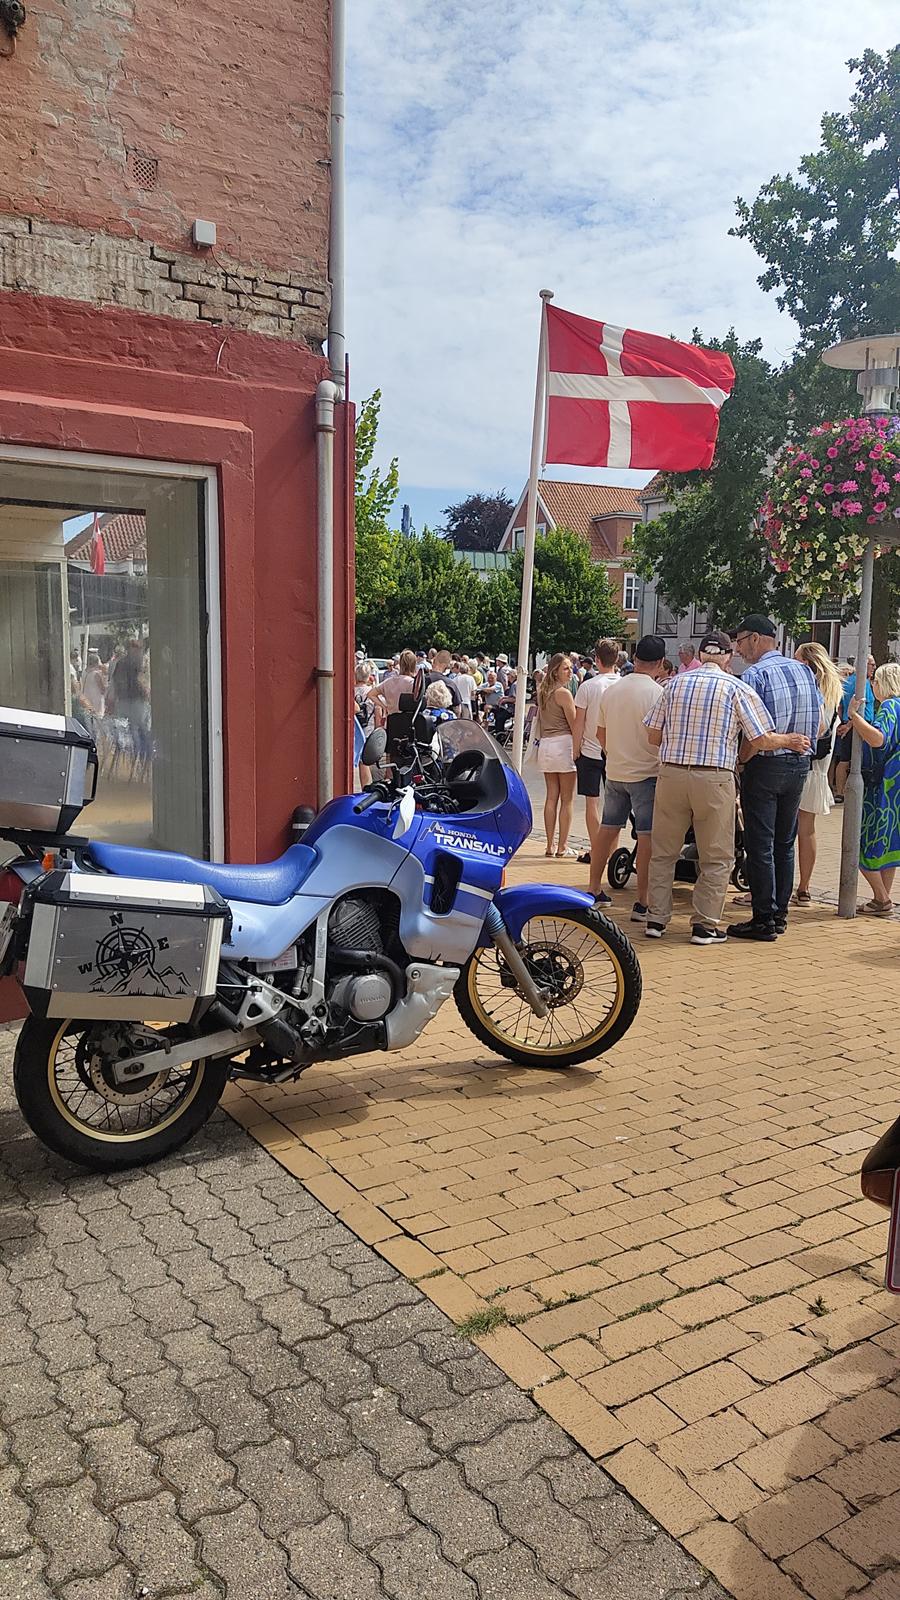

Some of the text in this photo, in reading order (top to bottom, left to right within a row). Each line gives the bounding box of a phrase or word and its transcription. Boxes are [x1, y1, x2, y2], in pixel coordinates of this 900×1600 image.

[447, 829, 477, 839] HONDA
[434, 833, 506, 856] TRANSALP
[109, 912, 124, 926] N
[157, 936, 169, 951] E
[78, 962, 93, 975] W
